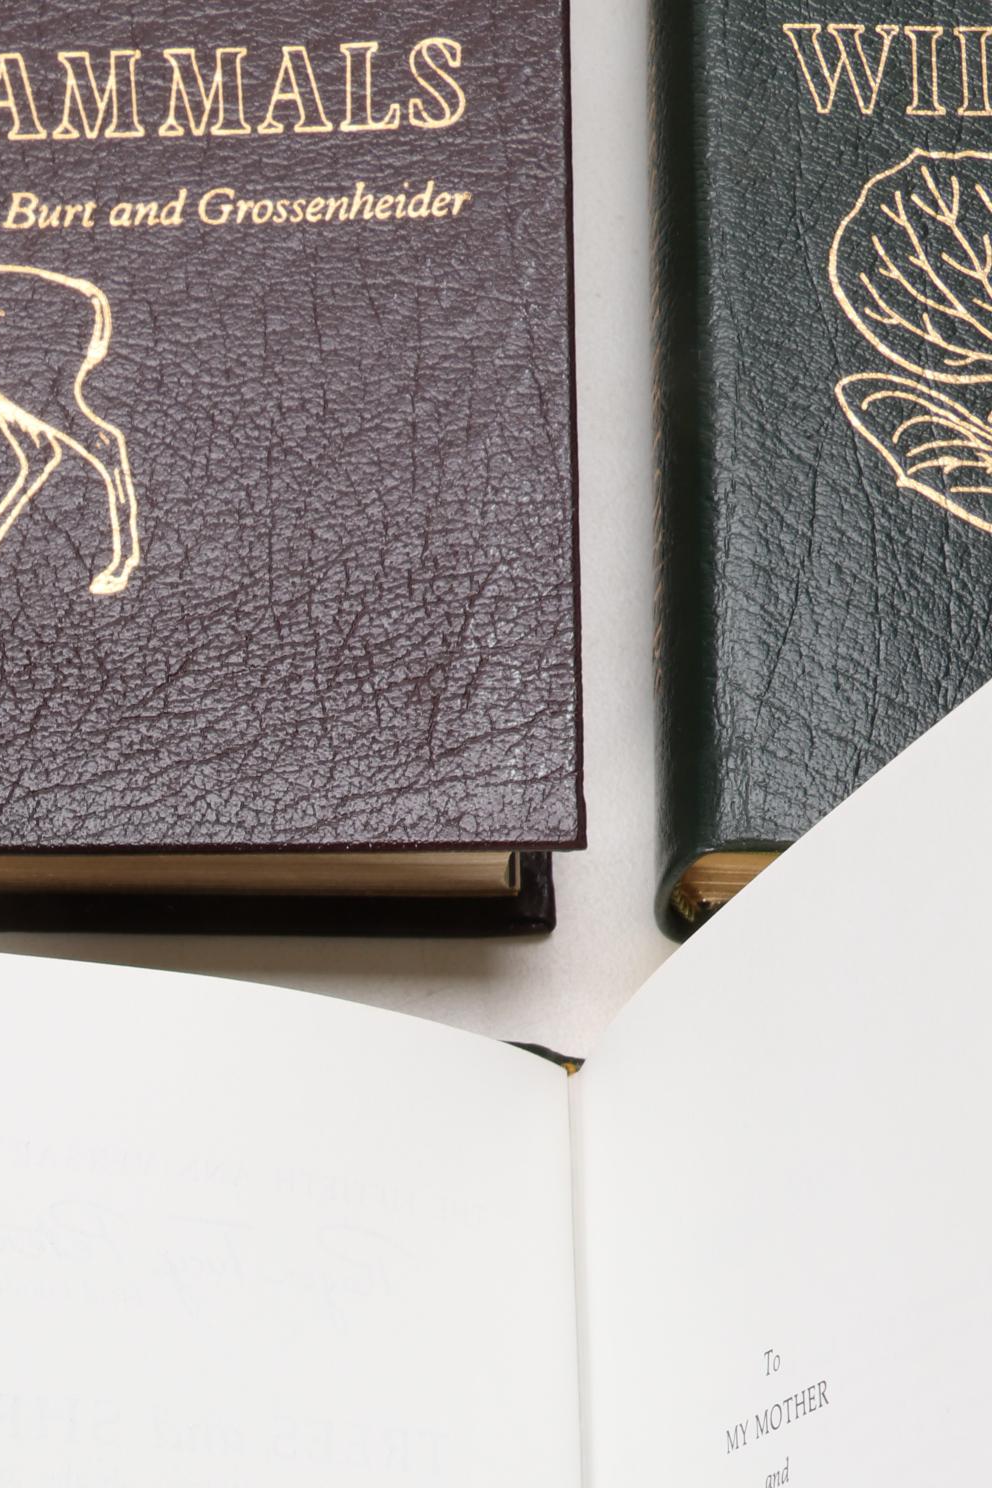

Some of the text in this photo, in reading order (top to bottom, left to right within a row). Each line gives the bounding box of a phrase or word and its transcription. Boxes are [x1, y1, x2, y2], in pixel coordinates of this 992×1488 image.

[2, 180, 472, 230] Burt and Grossenheider
[763, 1349, 781, 1376] To
[726, 1380, 829, 1454] MY MOTHER
